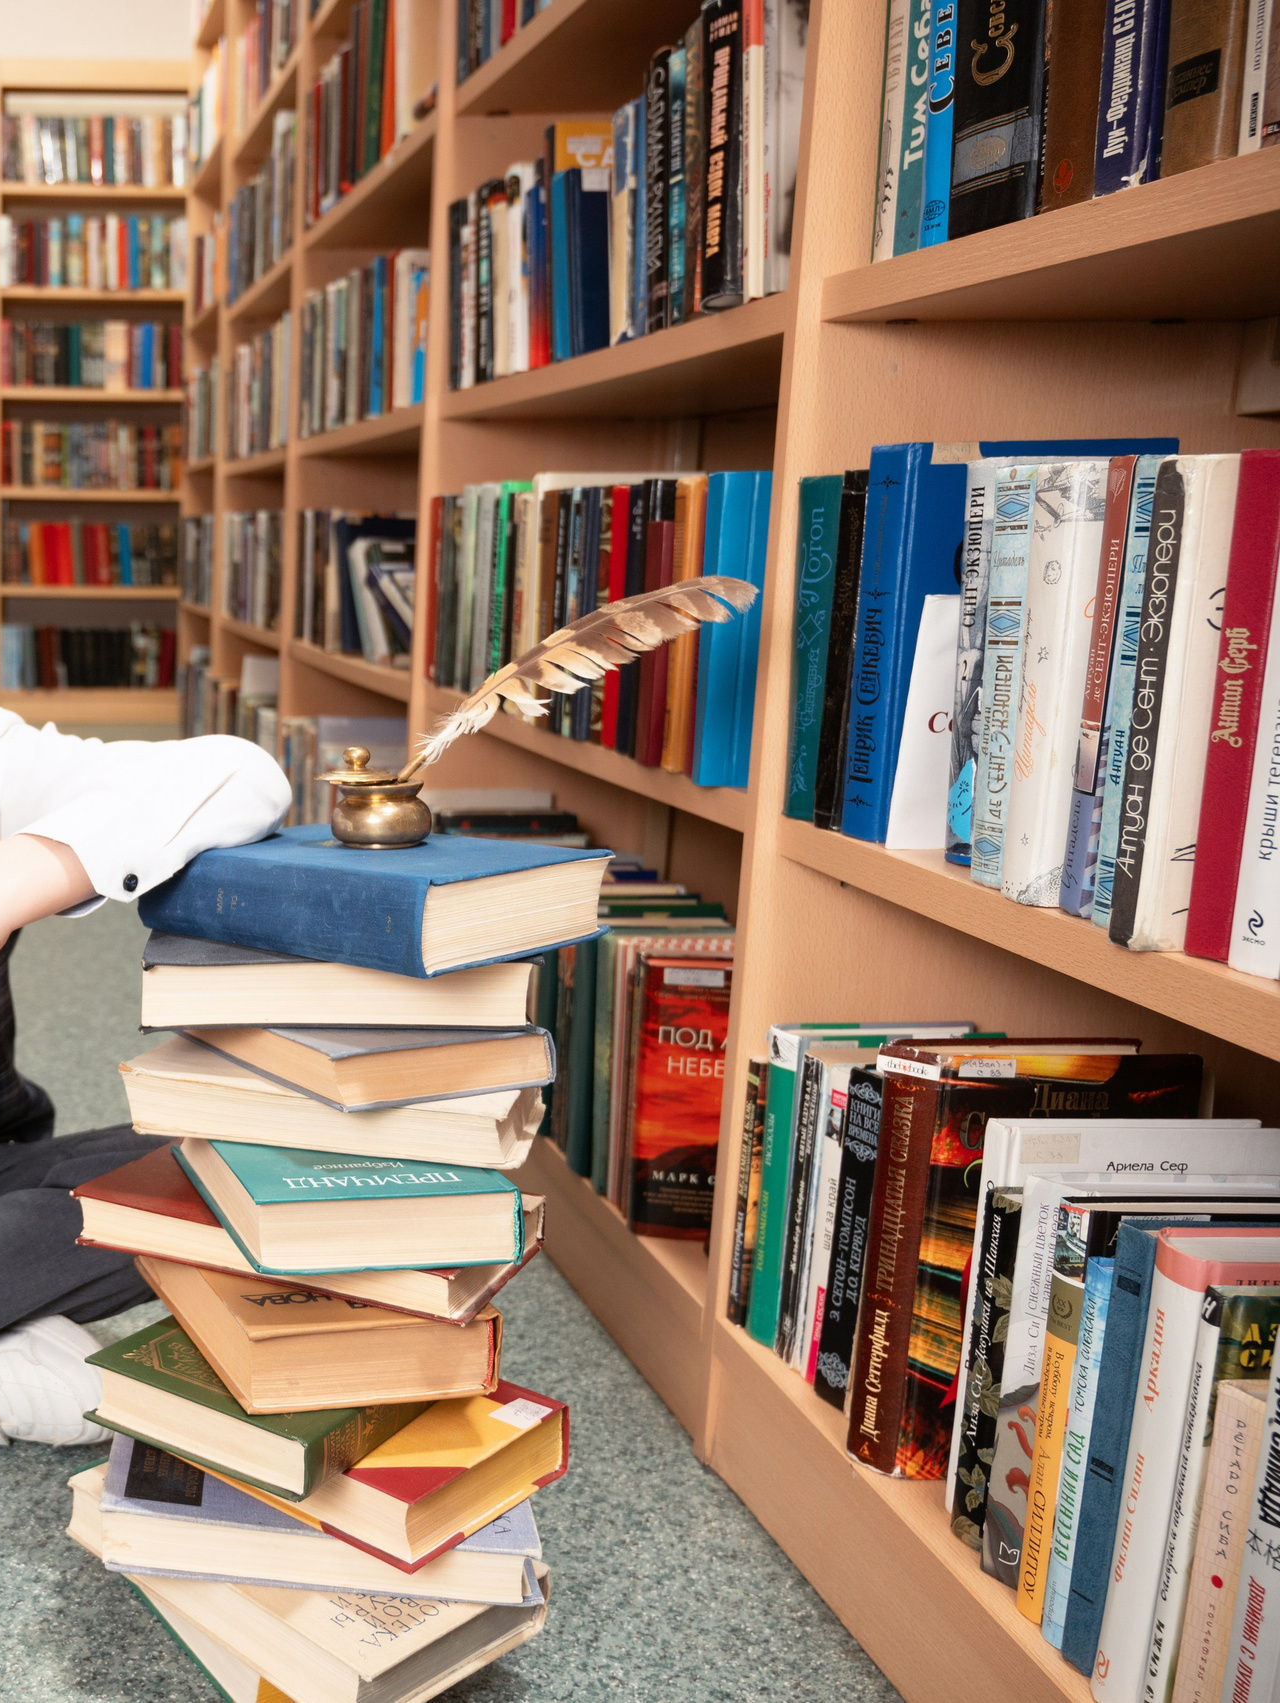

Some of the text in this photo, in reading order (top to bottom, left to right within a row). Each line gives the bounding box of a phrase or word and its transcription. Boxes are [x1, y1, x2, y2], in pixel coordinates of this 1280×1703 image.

[903, 96, 927, 171] Тим
[1102, 31, 1135, 159] Луи-Фердинанд
[961, 485, 987, 628] СЕНТ-ЭКЗЮПЕРИ
[1092, 530, 1122, 682] СЕНТ-ЭКЗЮПЕРИ
[1115, 503, 1178, 877] Антуан де Сент Экзюпери
[1210, 626, 1258, 749] Антал Серб
[657, 1025, 714, 1052] ПОД
[850, 1097, 881, 1118] КНИГИ
[282, 1172, 464, 1192] ПРЕМЧАНД
[821, 1177, 837, 1251] шаг за край
[874, 1095, 915, 1293] ТРИНАДЦАТАЯ СКАЗКА
[1106, 1160, 1189, 1175] Ариела Сеф
[830, 1177, 857, 1307] СЕТОН-ТОМПСОН
[847, 1216, 867, 1272] КЕРВУД
[973, 1213, 1002, 1370] Девушки из Шанхая
[860, 1308, 891, 1444] Диана Сеттерфилд
[1022, 1320, 1041, 1377] Лиза Си
[1048, 1360, 1063, 1397] субботу
[1073, 1298, 1097, 1414] ТОМОКА СИБАСАКИ
[1141, 1308, 1167, 1415] Аркадия
[964, 1373, 984, 1446] Лиза Си
[1021, 1445, 1052, 1600] Алан СИЛЛИТОУ
[1054, 1430, 1086, 1563] ВЕСЕННИЙ САД
[1126, 1453, 1145, 1516] Сидни
[1240, 1576, 1267, 1645] ДВОЙНИК
